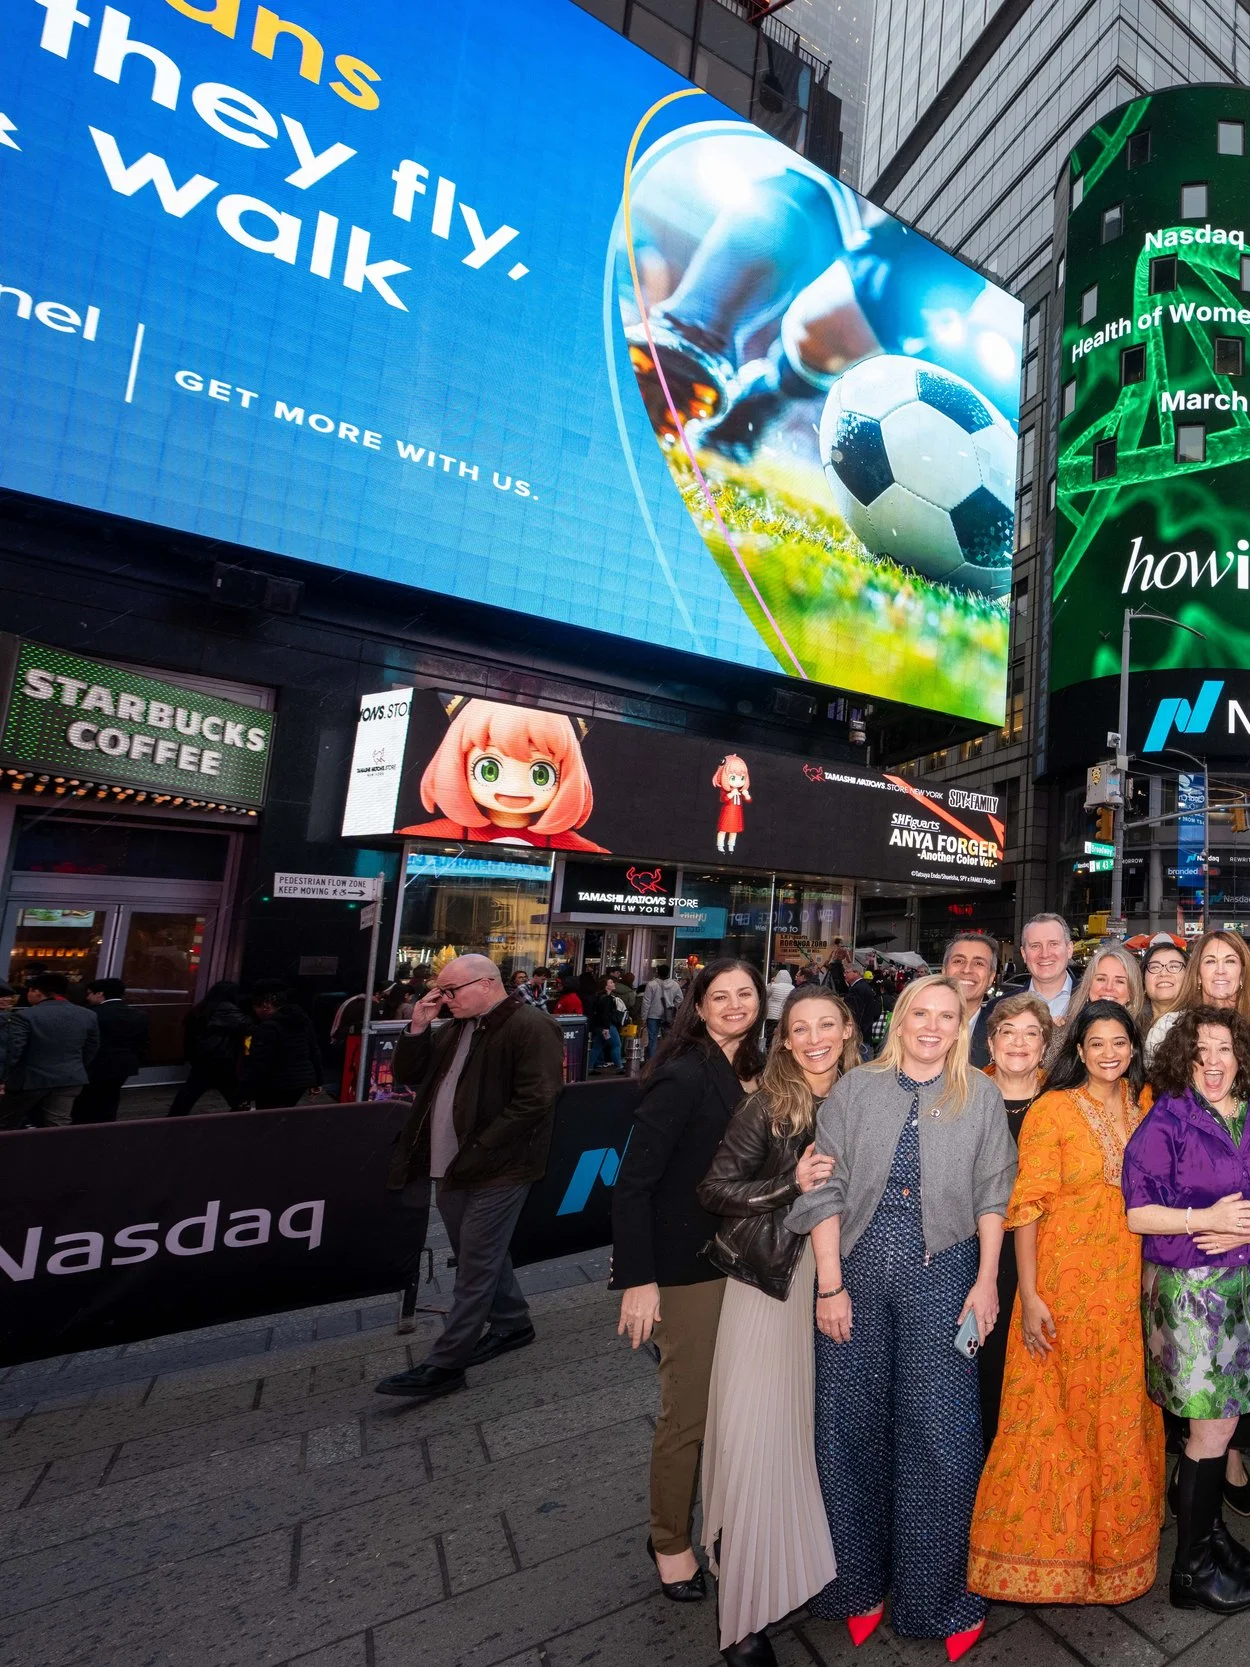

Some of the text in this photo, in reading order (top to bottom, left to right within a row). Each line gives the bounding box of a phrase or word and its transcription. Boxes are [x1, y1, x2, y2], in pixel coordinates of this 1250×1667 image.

[88, 125, 412, 313] walk
[1144, 224, 1245, 253] Nasdaq
[1071, 317, 1132, 364] Health
[1137, 306, 1163, 329] of
[1160, 388, 1249, 413] March
[174, 369, 541, 501] GET MORE WITH US.
[22, 666, 267, 754] STARBUCKS
[66, 719, 222, 777] COFFEE
[824, 772, 856, 784] TAMASHII
[909, 787, 925, 797] NEW
[925, 790, 943, 800] YORK
[889, 829, 998, 858] ANYA FORGER
[956, 854, 979, 866] Color
[1168, 867, 1198, 875] branded
[279, 876, 325, 886] PEDESTRIAN
[328, 879, 347, 887] FLOW
[279, 886, 329, 896] KEEP MOVING
[578, 892, 699, 909] TAMASHII NATIONS STORE
[614, 904, 666, 914] NEW YORK
[0, 1200, 326, 1281] Nasdaq
